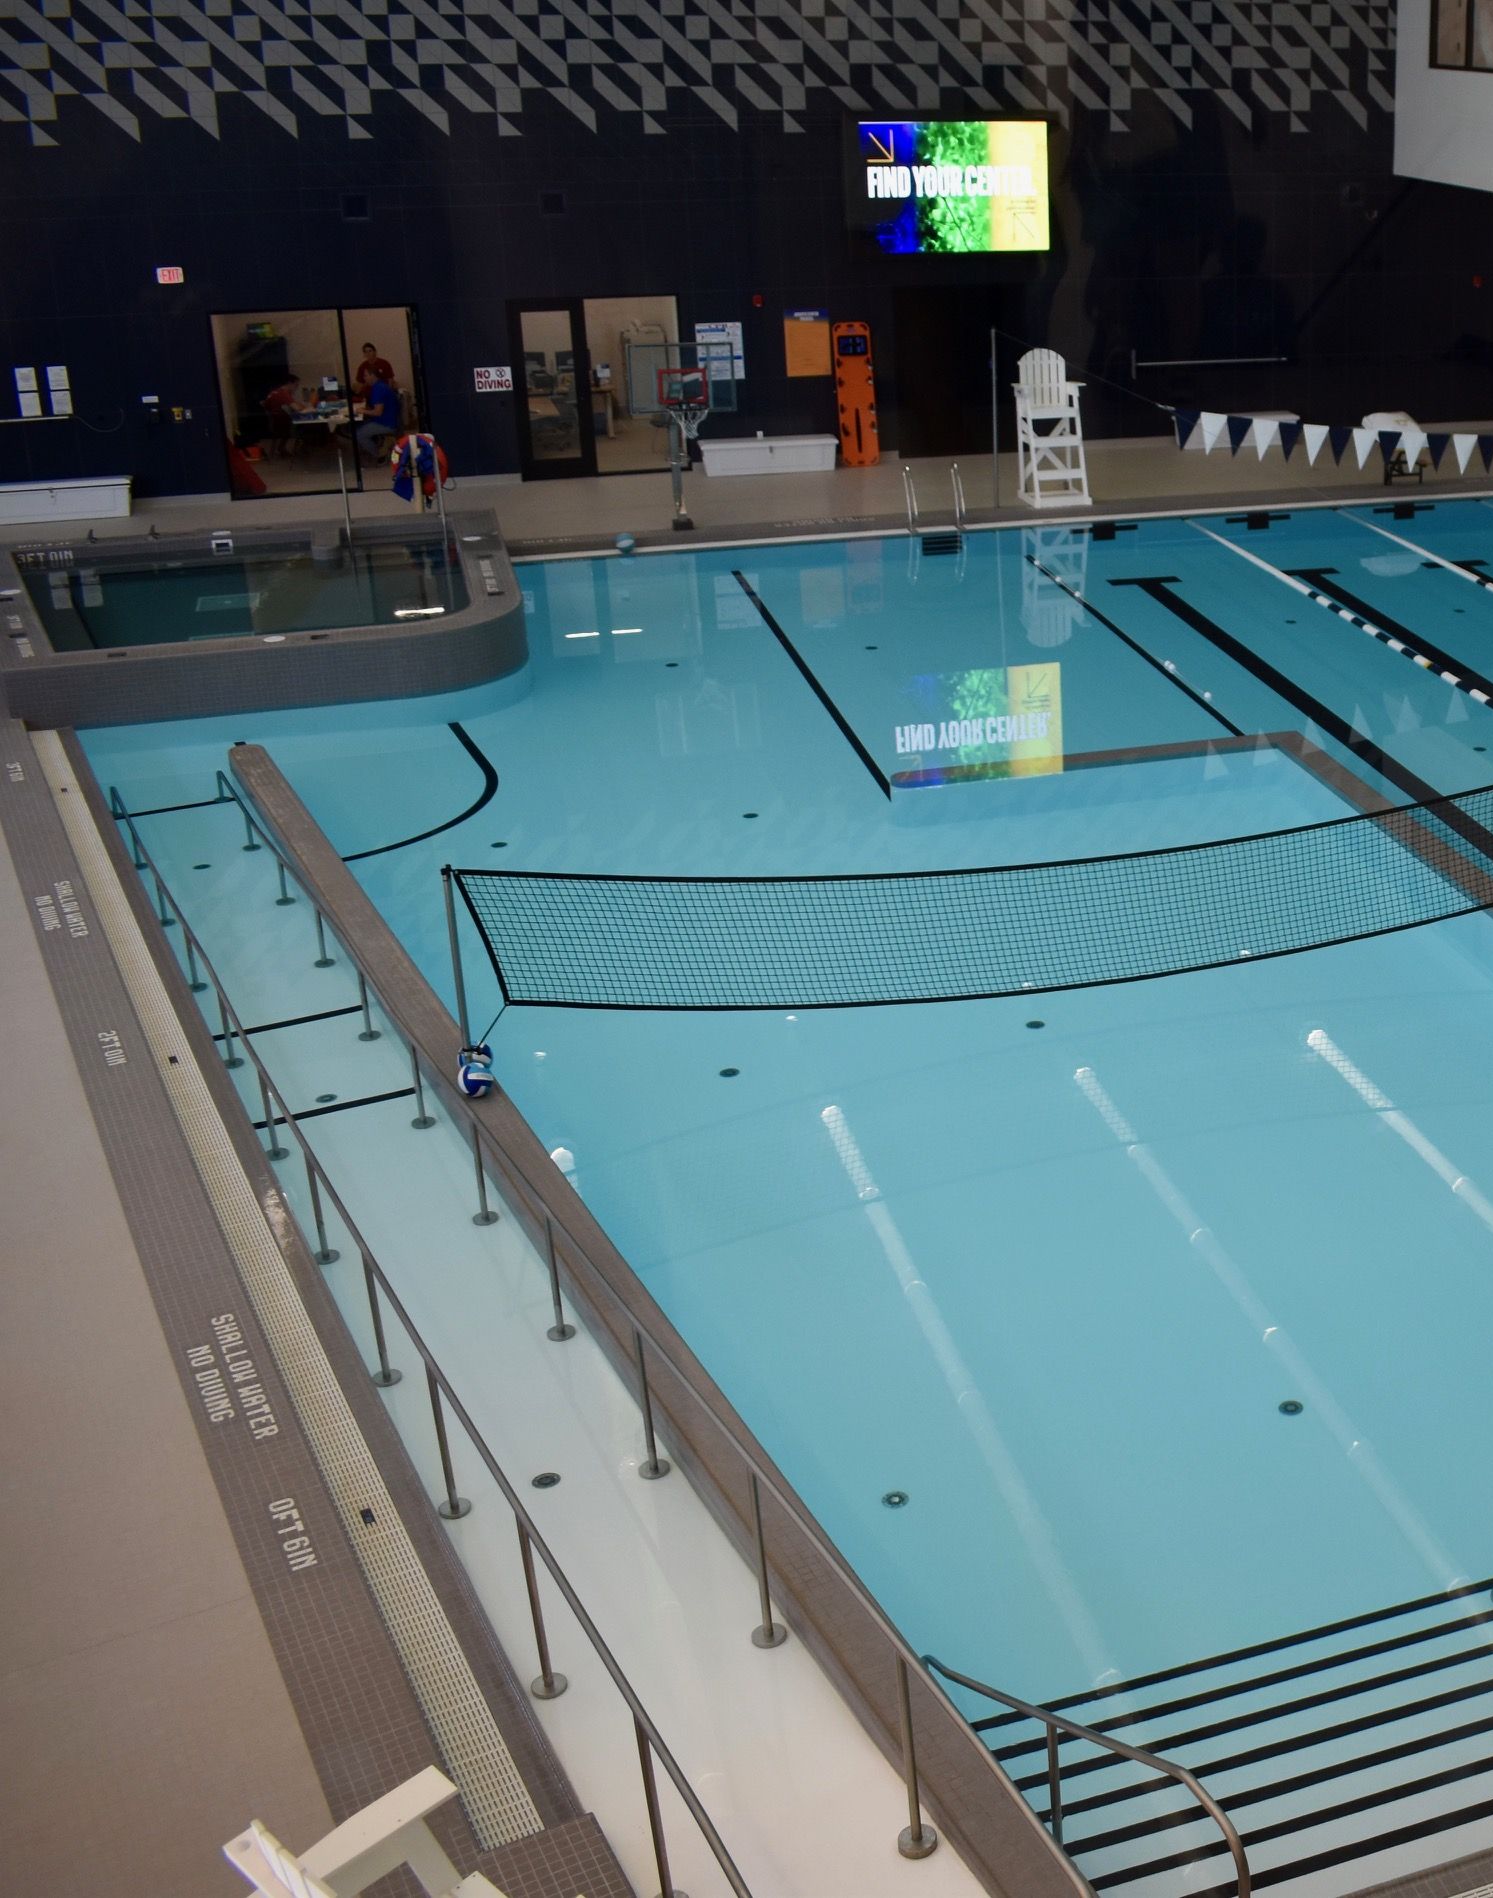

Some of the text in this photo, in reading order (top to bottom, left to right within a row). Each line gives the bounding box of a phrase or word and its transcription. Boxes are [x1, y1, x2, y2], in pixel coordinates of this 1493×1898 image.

[867, 165, 911, 198] FIND
[911, 165, 964, 198] YOUR
[160, 269, 180, 282] EXIT
[475, 369, 491, 380] NO
[476, 379, 512, 390] DIVING
[34, 894, 61, 931] NO DIVING
[54, 880, 89, 938] SHALLOW WATER
[187, 1344, 236, 1423] NO DIVING
[211, 1313, 279, 1440] SHALLOW WATER
[282, 1535, 318, 1572] 6IN
